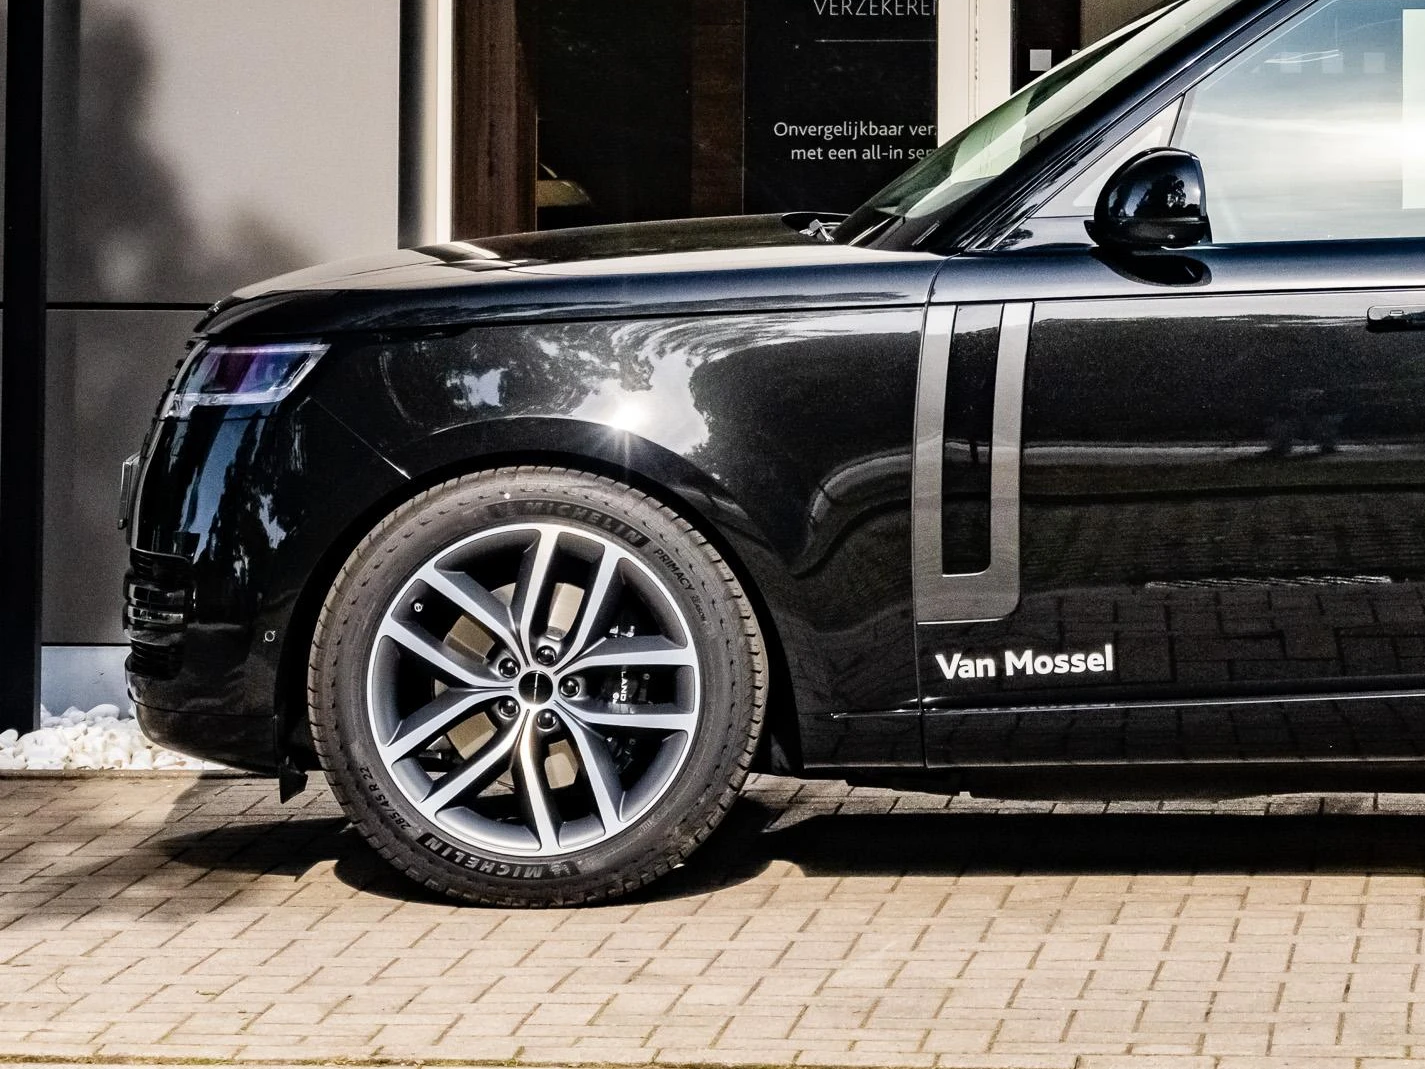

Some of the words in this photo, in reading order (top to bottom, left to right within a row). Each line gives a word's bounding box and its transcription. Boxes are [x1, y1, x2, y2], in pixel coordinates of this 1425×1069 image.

[773, 120, 905, 141] Onvergelijkbaar
[908, 124, 937, 136] ver
[791, 147, 824, 160] met
[828, 148, 857, 160] een
[862, 144, 903, 160] all-in
[531, 501, 645, 548] MICHELIN
[653, 548, 696, 592] PRIMACY
[935, 652, 996, 680] Van
[1004, 643, 1114, 677] Mossel
[360, 766, 374, 780] 22
[368, 782, 380, 793] R
[375, 793, 412, 830] 285/45
[423, 837, 545, 879] MICHELIN
